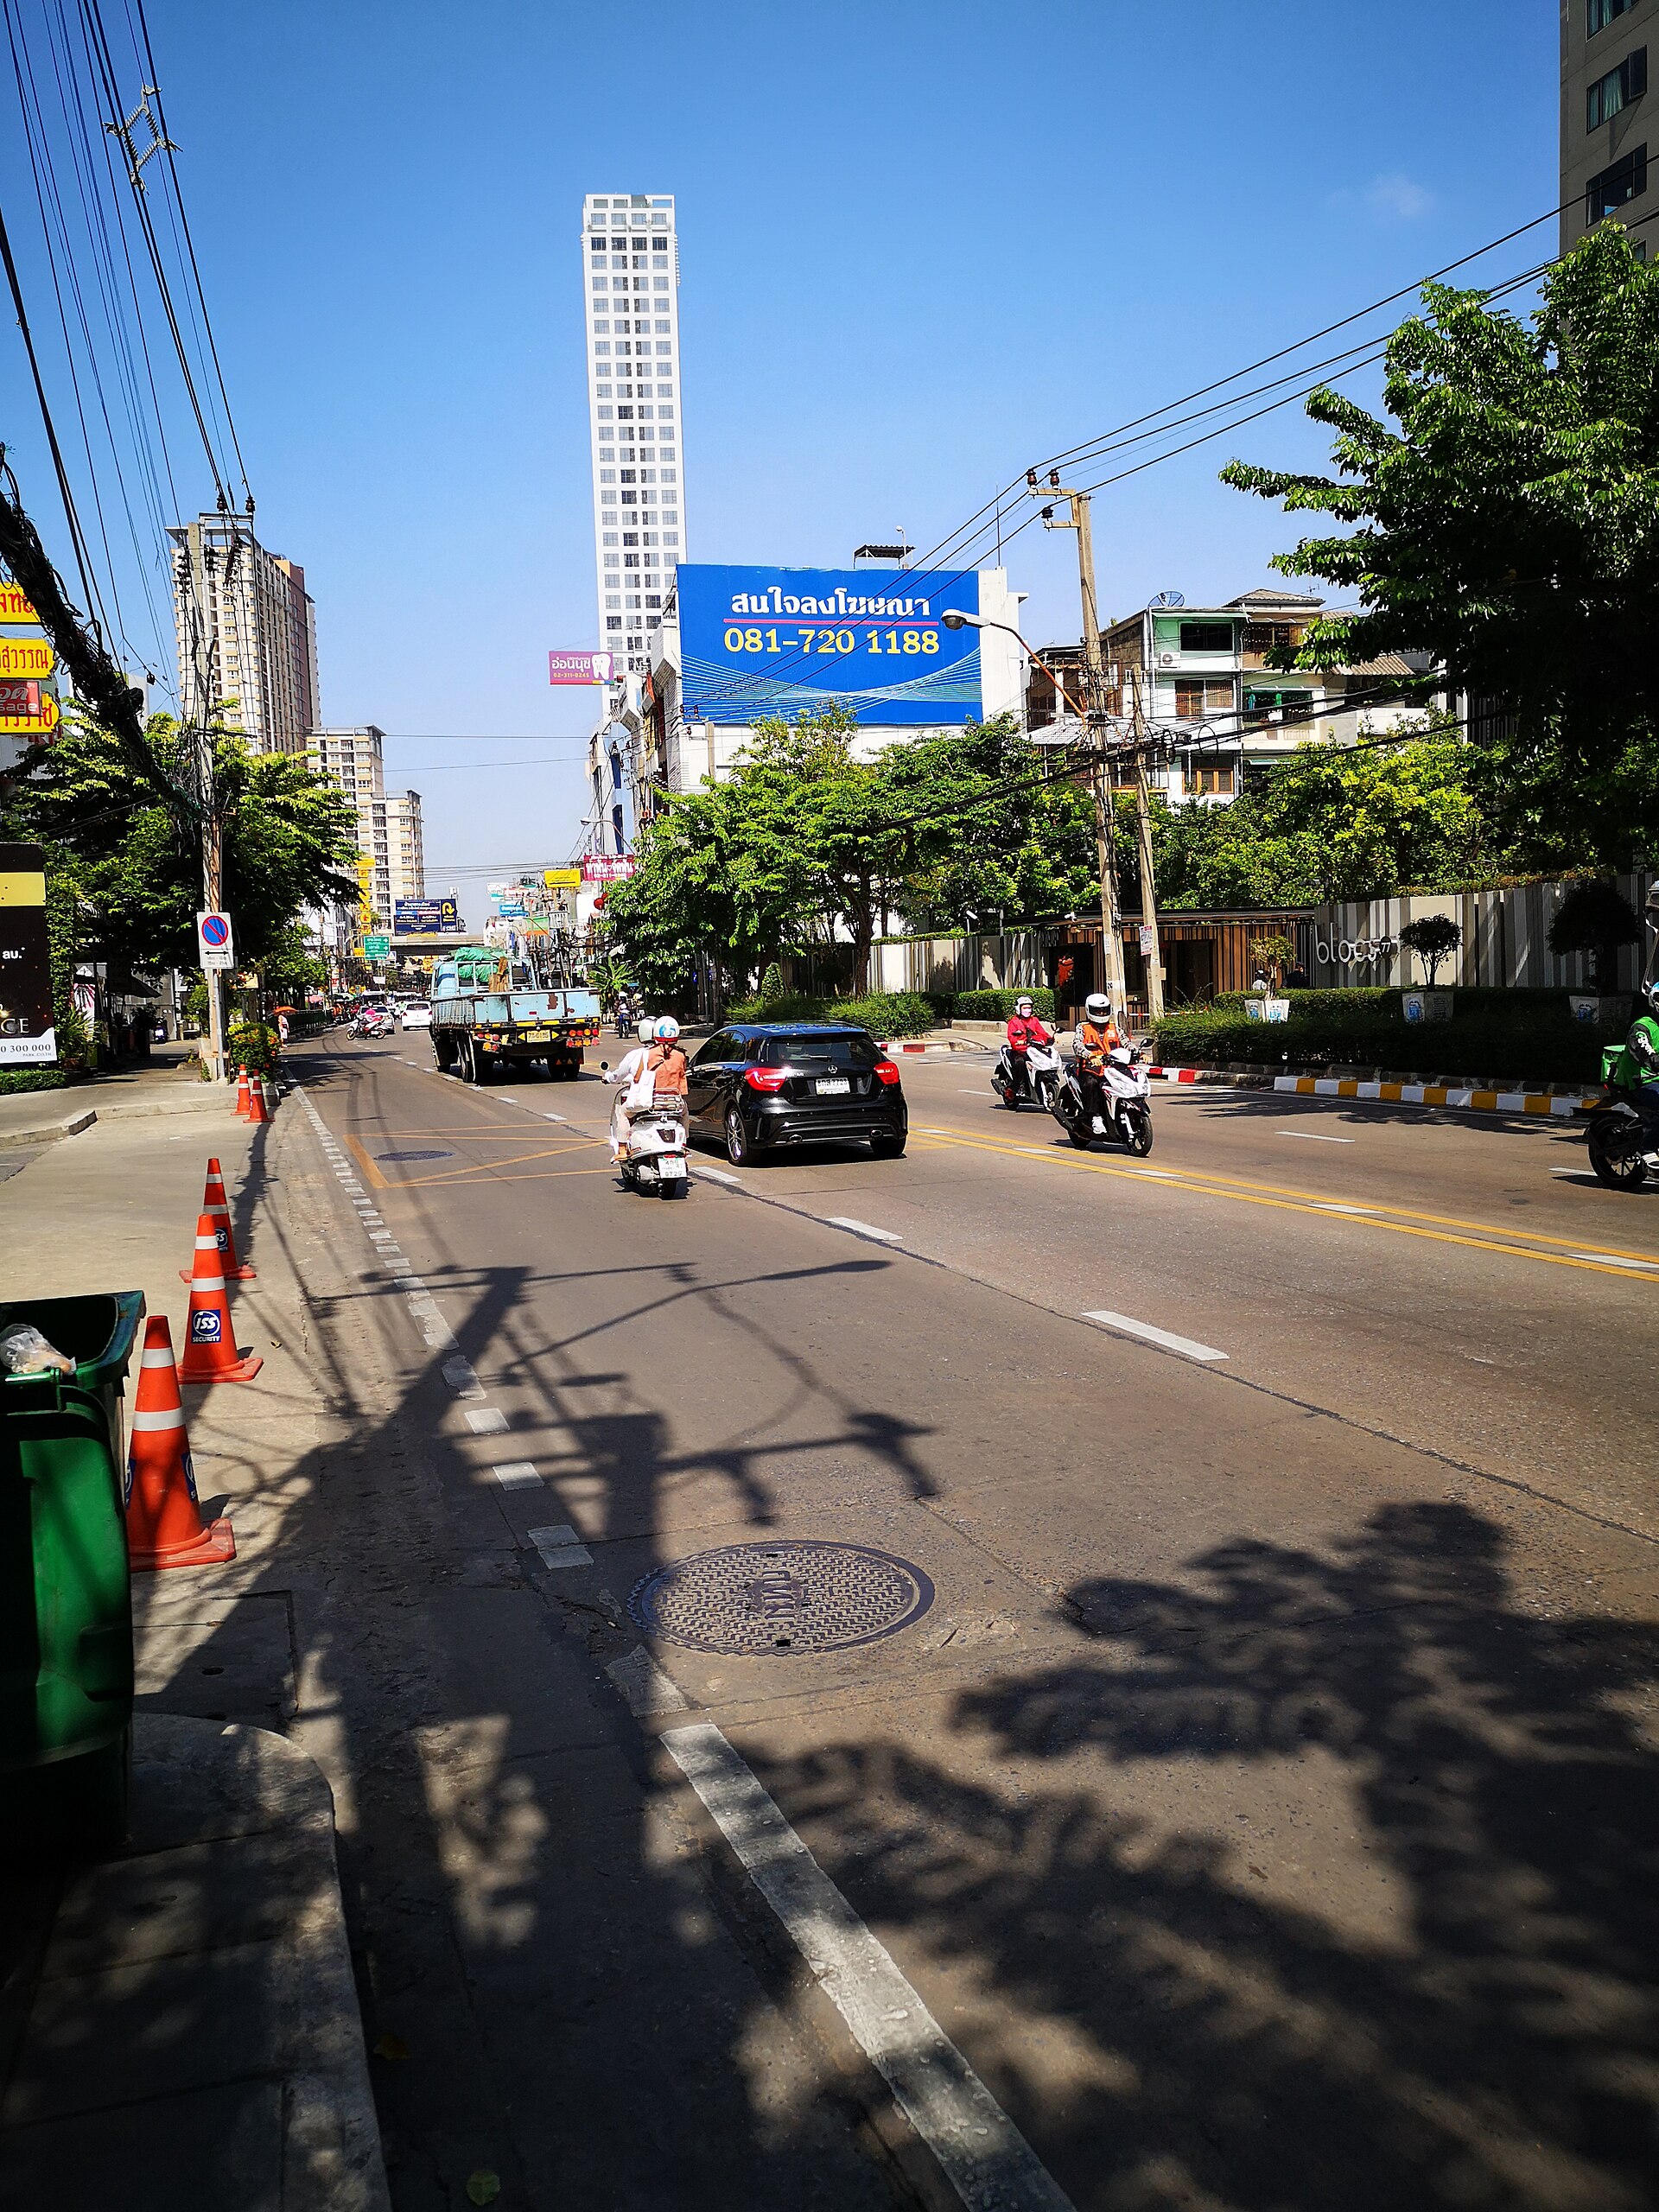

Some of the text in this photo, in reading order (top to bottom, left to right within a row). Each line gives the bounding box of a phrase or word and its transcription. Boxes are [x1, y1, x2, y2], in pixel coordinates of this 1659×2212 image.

[731, 586, 931, 616] สนใจลงโฆษณา
[724, 627, 940, 655] 081-720 1188
[0, 645, 49, 673] สุวรรณ
[552, 657, 591, 672] อ่อนนุช
